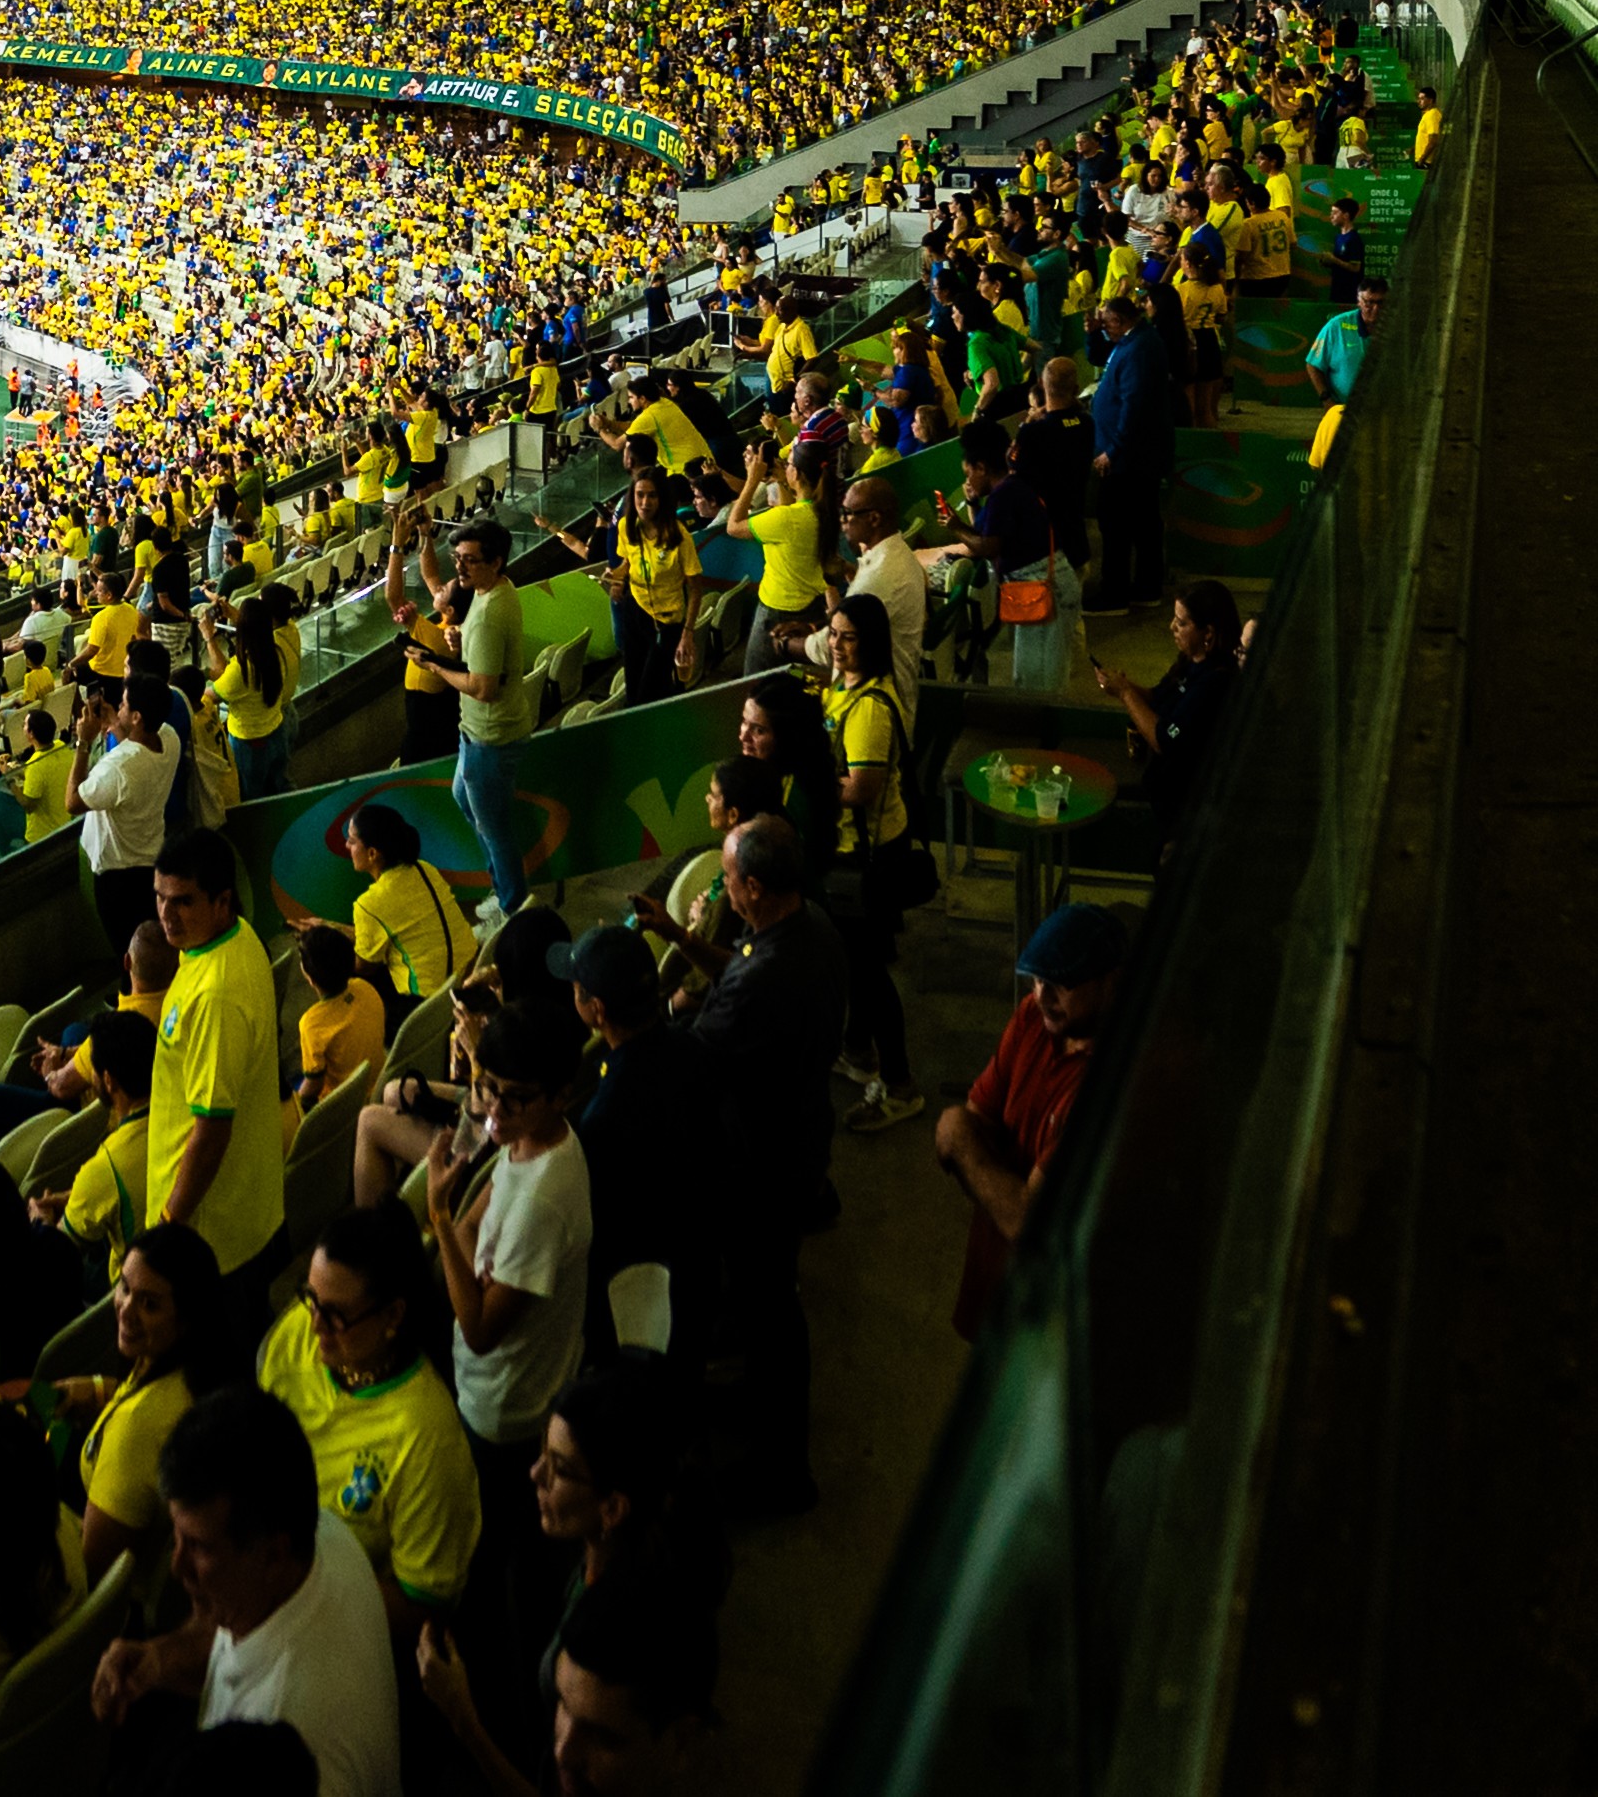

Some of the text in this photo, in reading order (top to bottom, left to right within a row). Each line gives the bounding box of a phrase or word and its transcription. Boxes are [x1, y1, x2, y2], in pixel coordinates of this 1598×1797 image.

[3, 44, 111, 66] KEMELLI
[147, 57, 219, 76] ALINE
[282, 68, 391, 92] KAYLANE
[424, 79, 520, 108] ARTHUR E.
[535, 94, 647, 142] SELEÇÃO
[1370, 188, 1391, 198] ONDE
[1261, 230, 1287, 258] 13
